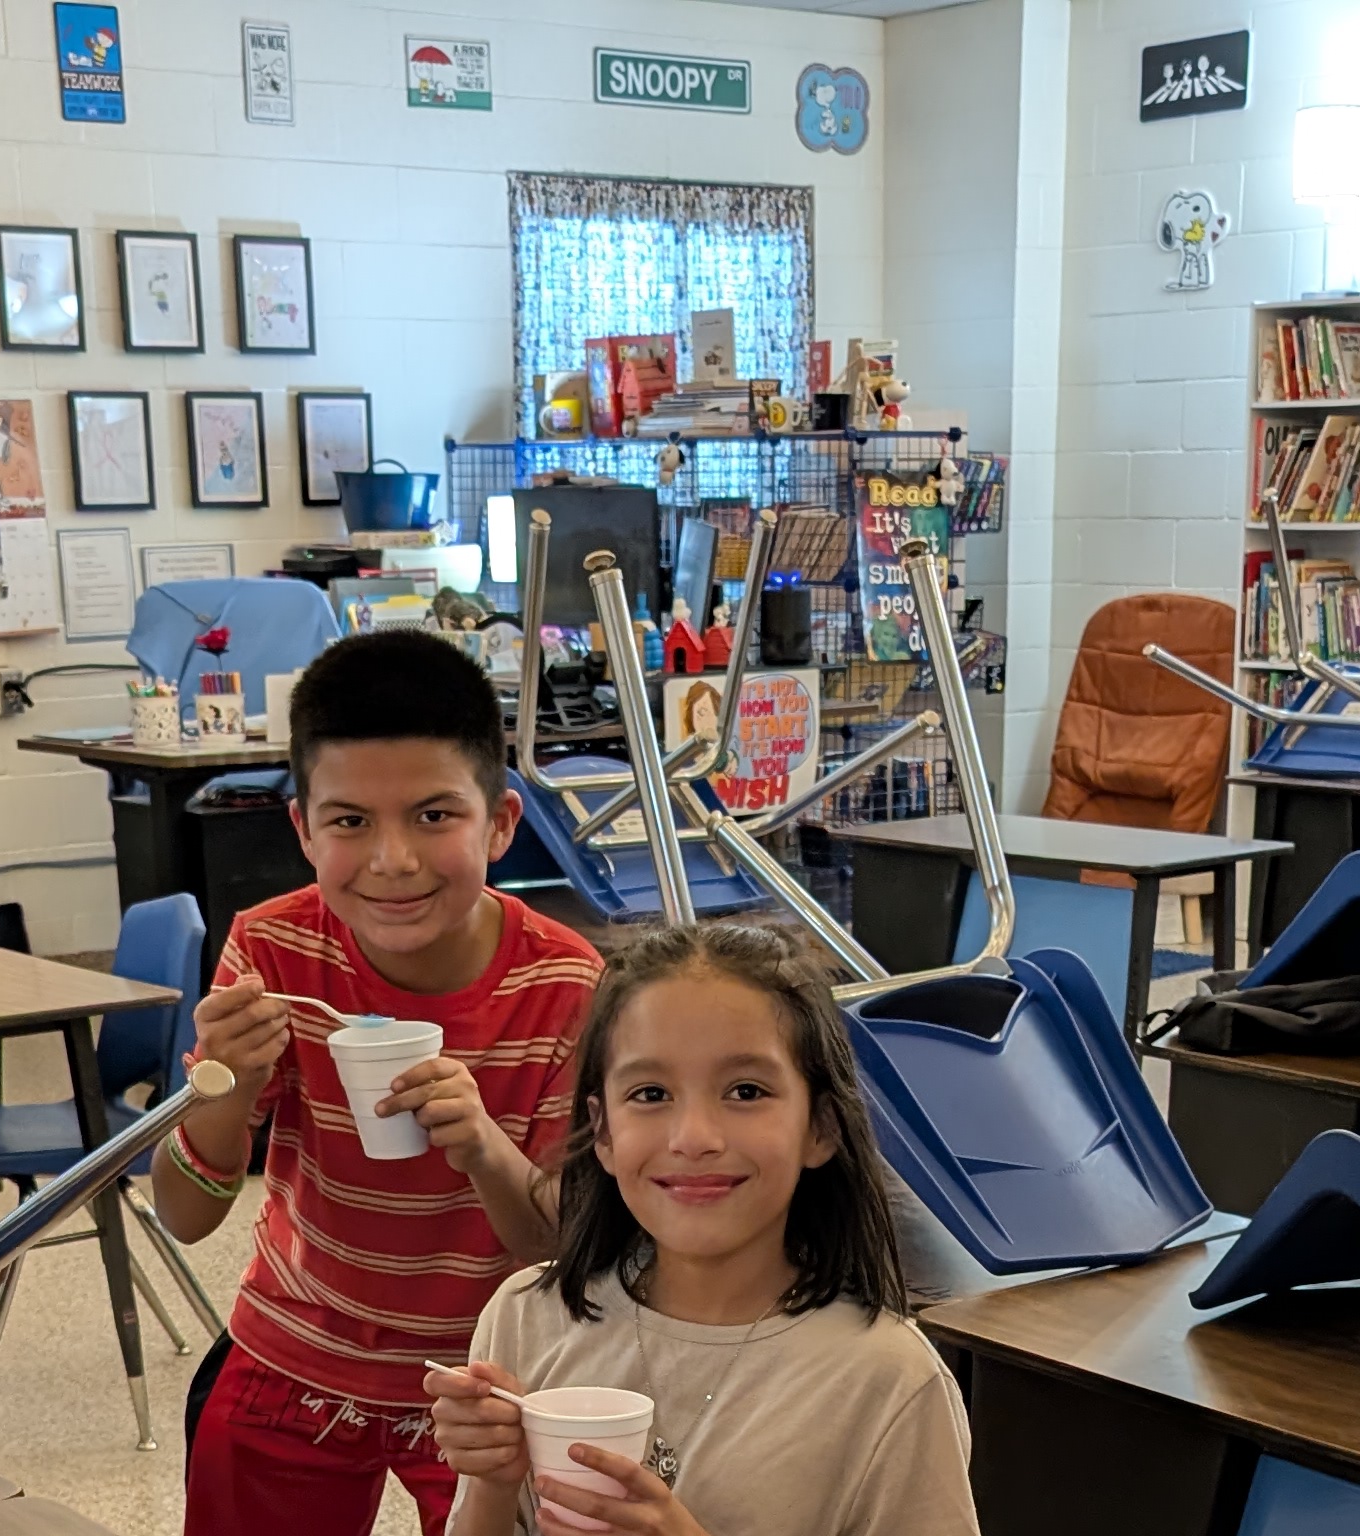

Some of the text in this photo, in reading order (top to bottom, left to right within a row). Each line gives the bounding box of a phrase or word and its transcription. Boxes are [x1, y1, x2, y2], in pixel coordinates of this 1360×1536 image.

[61, 72, 122, 92] TEAMWORK
[609, 60, 743, 102] SNOOPY DR
[868, 478, 938, 507] Read
[872, 512, 912, 538] It's
[891, 531, 940, 555] wt
[769, 680, 797, 699] NOT
[739, 695, 809, 718] HOW YOU
[740, 715, 808, 742] START
[770, 739, 806, 755] HOW
[751, 756, 788, 777] YOU
[716, 774, 791, 811] NISH
